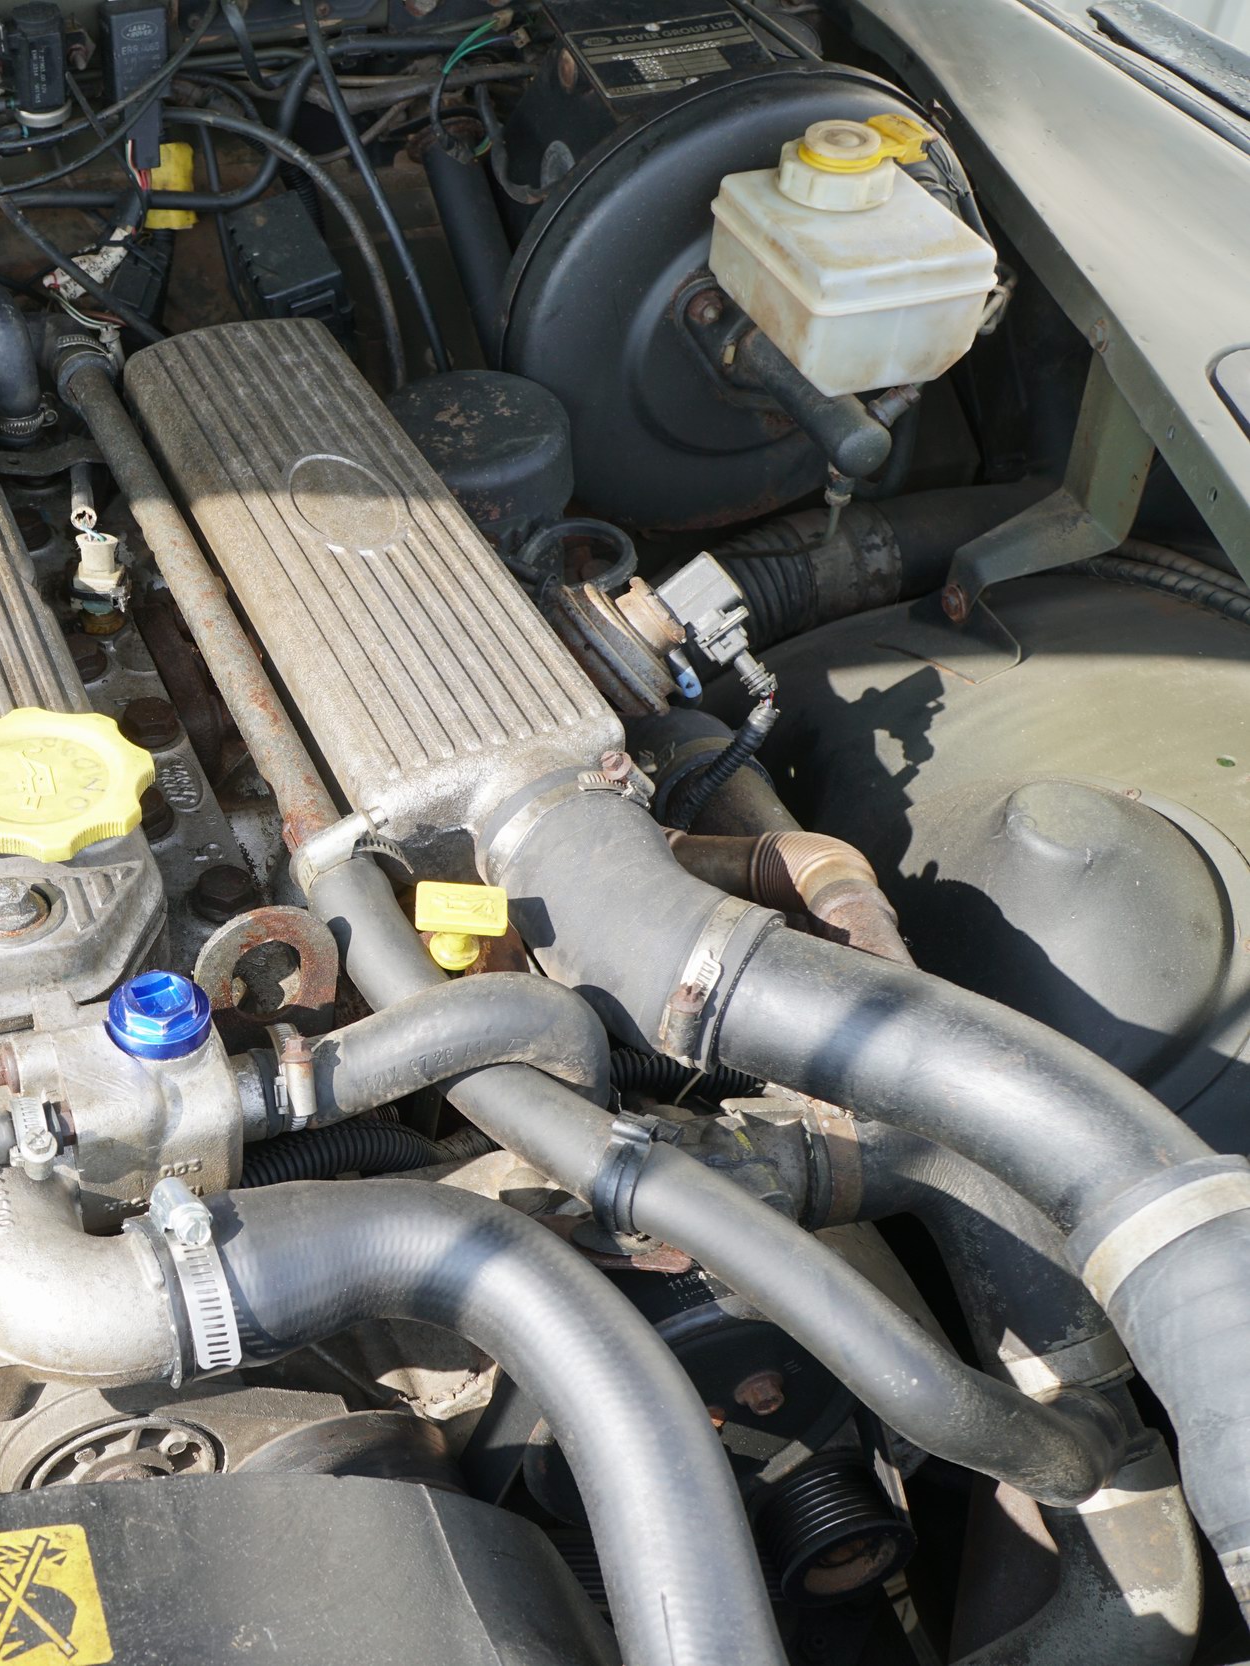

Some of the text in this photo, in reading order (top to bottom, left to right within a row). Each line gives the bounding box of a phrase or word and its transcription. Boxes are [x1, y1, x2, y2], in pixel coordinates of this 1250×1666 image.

[128, 24, 147, 32] LAND
[616, 31, 661, 44] ROVER
[663, 24, 709, 38] GROUP
[710, 19, 735, 31] LTD
[130, 29, 153, 38] ROVER
